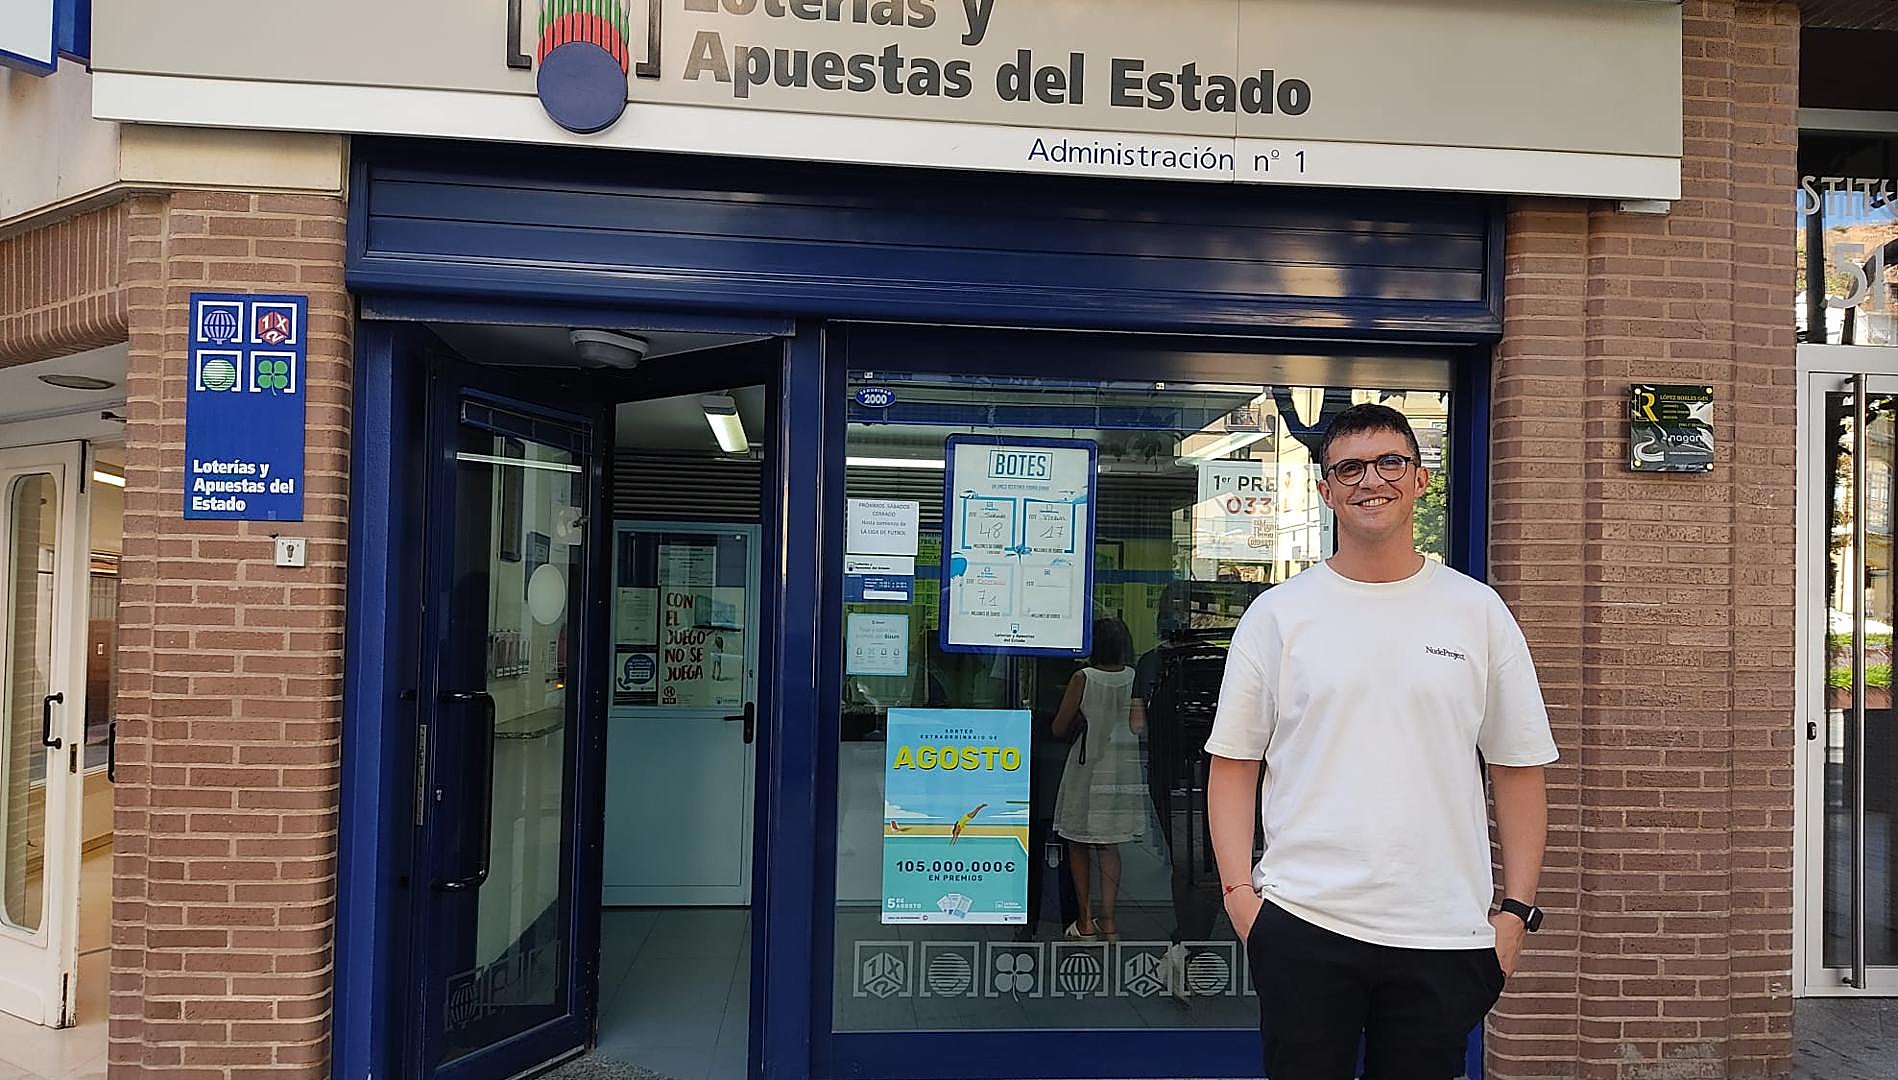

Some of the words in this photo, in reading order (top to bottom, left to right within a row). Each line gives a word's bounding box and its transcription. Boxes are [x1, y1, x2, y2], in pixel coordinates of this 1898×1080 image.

[961, 0, 995, 46] y
[683, 30, 973, 99] Apuestas
[995, 49, 1085, 105] del
[1110, 57, 1312, 116] Estado
[1028, 137, 1234, 171] Administración
[1295, 150, 1306, 173] 1
[864, 394, 888, 404] 2000
[193, 458, 256, 475] Loterías
[259, 463, 270, 478] y
[995, 453, 1046, 477] BOTES
[193, 478, 265, 495] Apuestas
[269, 478, 294, 494] del
[1238, 475, 1278, 491] PRE
[192, 496, 247, 512] Estado
[1226, 495, 1273, 514] 033
[979, 521, 1003, 540] 48
[666, 592, 694, 609] CON
[665, 611, 680, 627] EL
[665, 629, 706, 646] JUEGO
[664, 648, 685, 664] NO
[689, 647, 704, 663] SE
[1425, 645, 1466, 661] NudeProject
[664, 664, 704, 683] JUEGA
[893, 745, 1021, 771] AGOSTO
[896, 860, 1015, 873] 105.000.000€
[928, 874, 941, 882] EN
[943, 874, 983, 882] PREMIOS
[887, 897, 897, 909] 5
